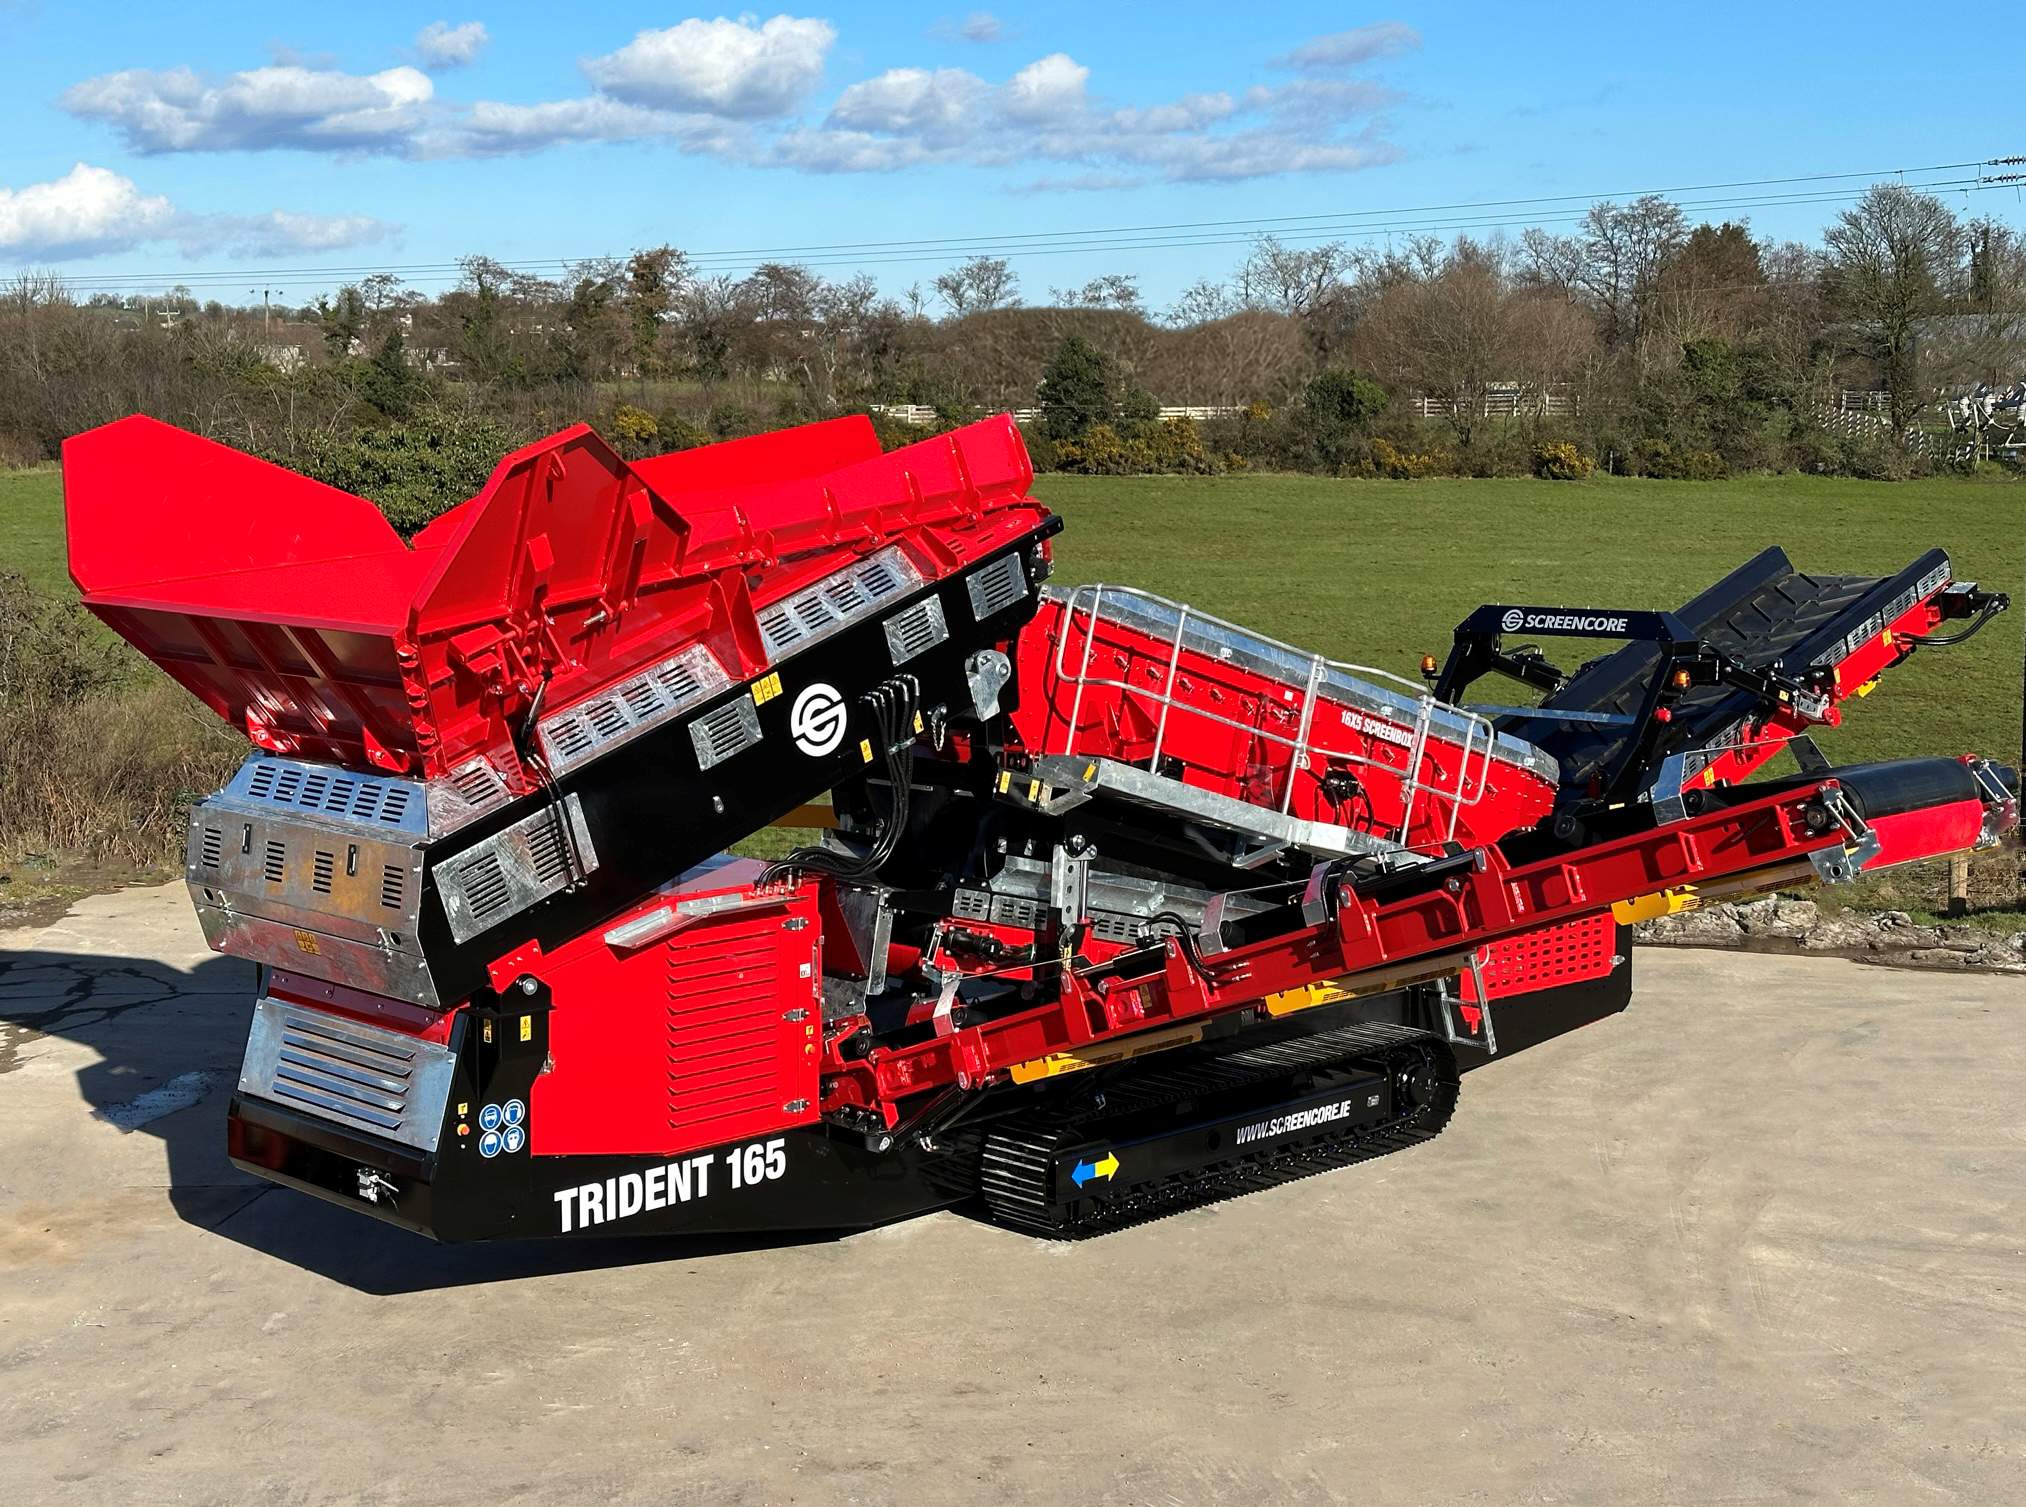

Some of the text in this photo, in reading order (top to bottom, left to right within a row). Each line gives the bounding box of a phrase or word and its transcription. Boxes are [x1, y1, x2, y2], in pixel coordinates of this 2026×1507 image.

[1525, 614, 1628, 632] SCREENCORE
[1340, 710, 1414, 748] 16X5 SCREENBOX
[1236, 1099, 1352, 1145] WWW.SCREENCORE.IE
[554, 1138, 787, 1233] TRIDENT 165
